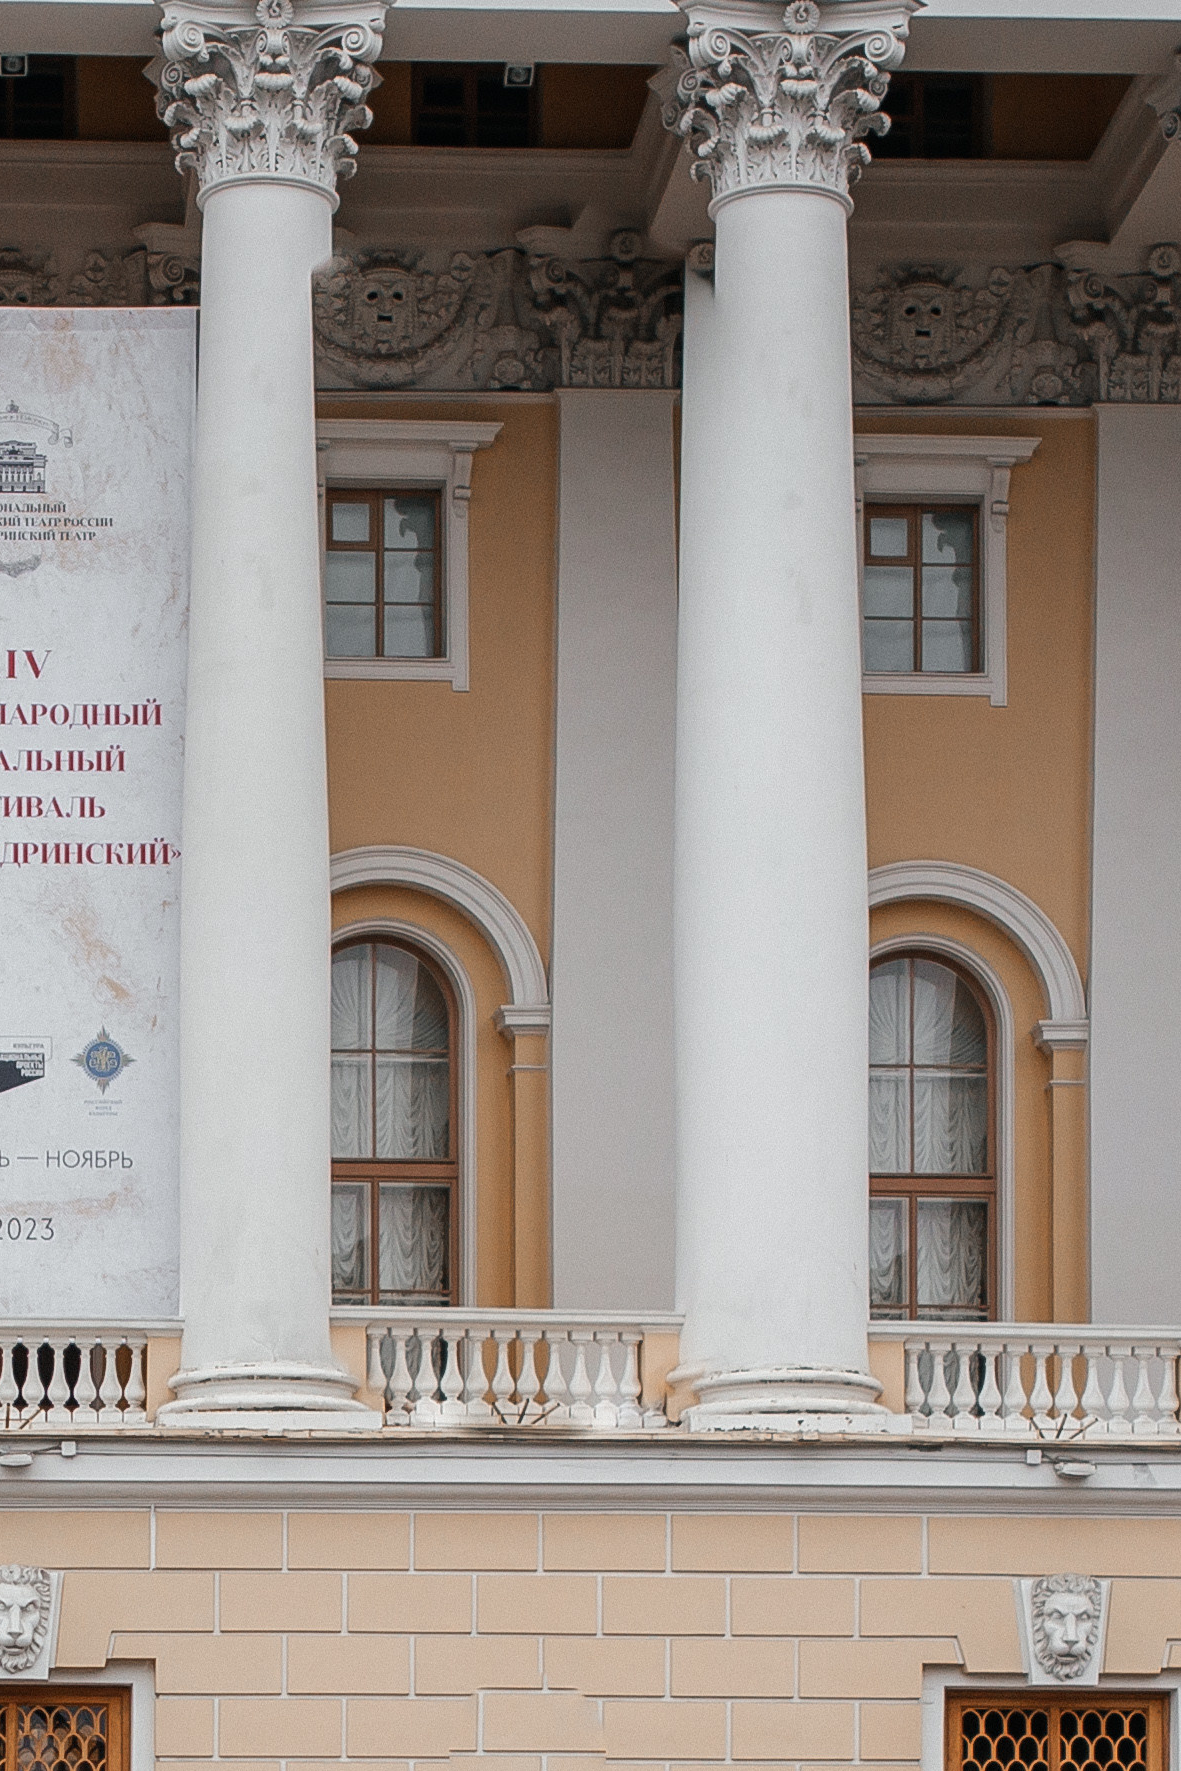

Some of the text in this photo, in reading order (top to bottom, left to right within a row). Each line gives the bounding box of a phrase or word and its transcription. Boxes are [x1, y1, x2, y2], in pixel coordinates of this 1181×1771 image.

[24, 517, 62, 527] ТЕАТР
[63, 517, 114, 528] РОССИИ
[58, 531, 97, 541] ТЕАТР
[45, 1149, 134, 1169] НОЯБРЬ
